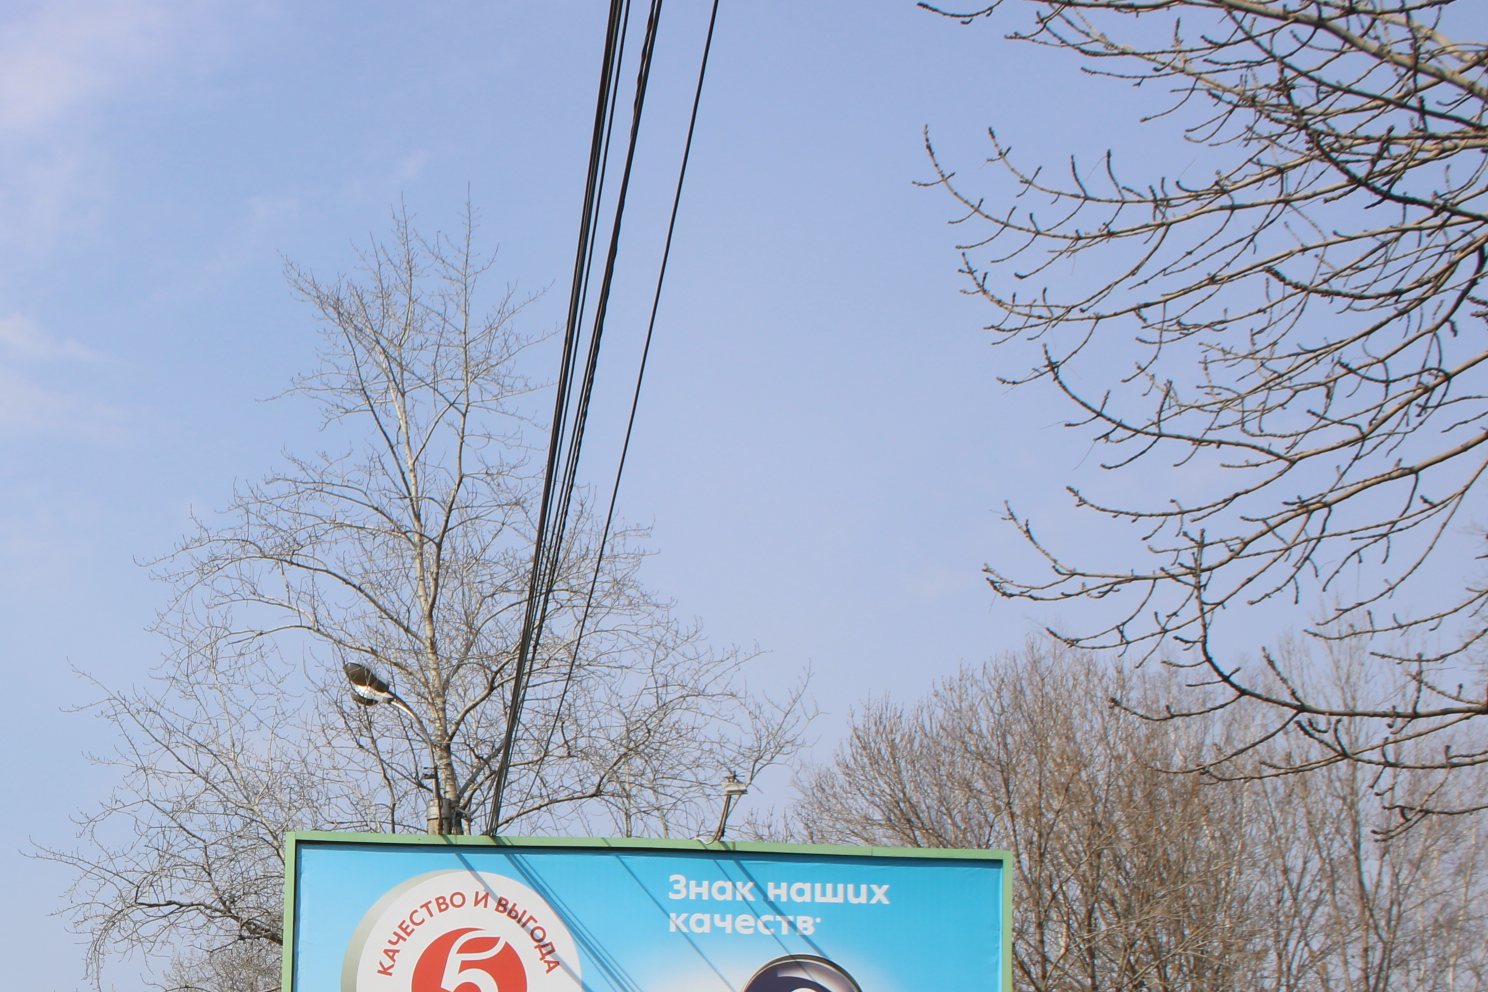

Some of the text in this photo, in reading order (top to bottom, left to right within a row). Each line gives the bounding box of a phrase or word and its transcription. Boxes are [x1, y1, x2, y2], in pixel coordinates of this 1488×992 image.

[668, 874, 890, 905] Знак наших
[376, 891, 561, 977] КАЧЕСТВО И ВЫГОДА
